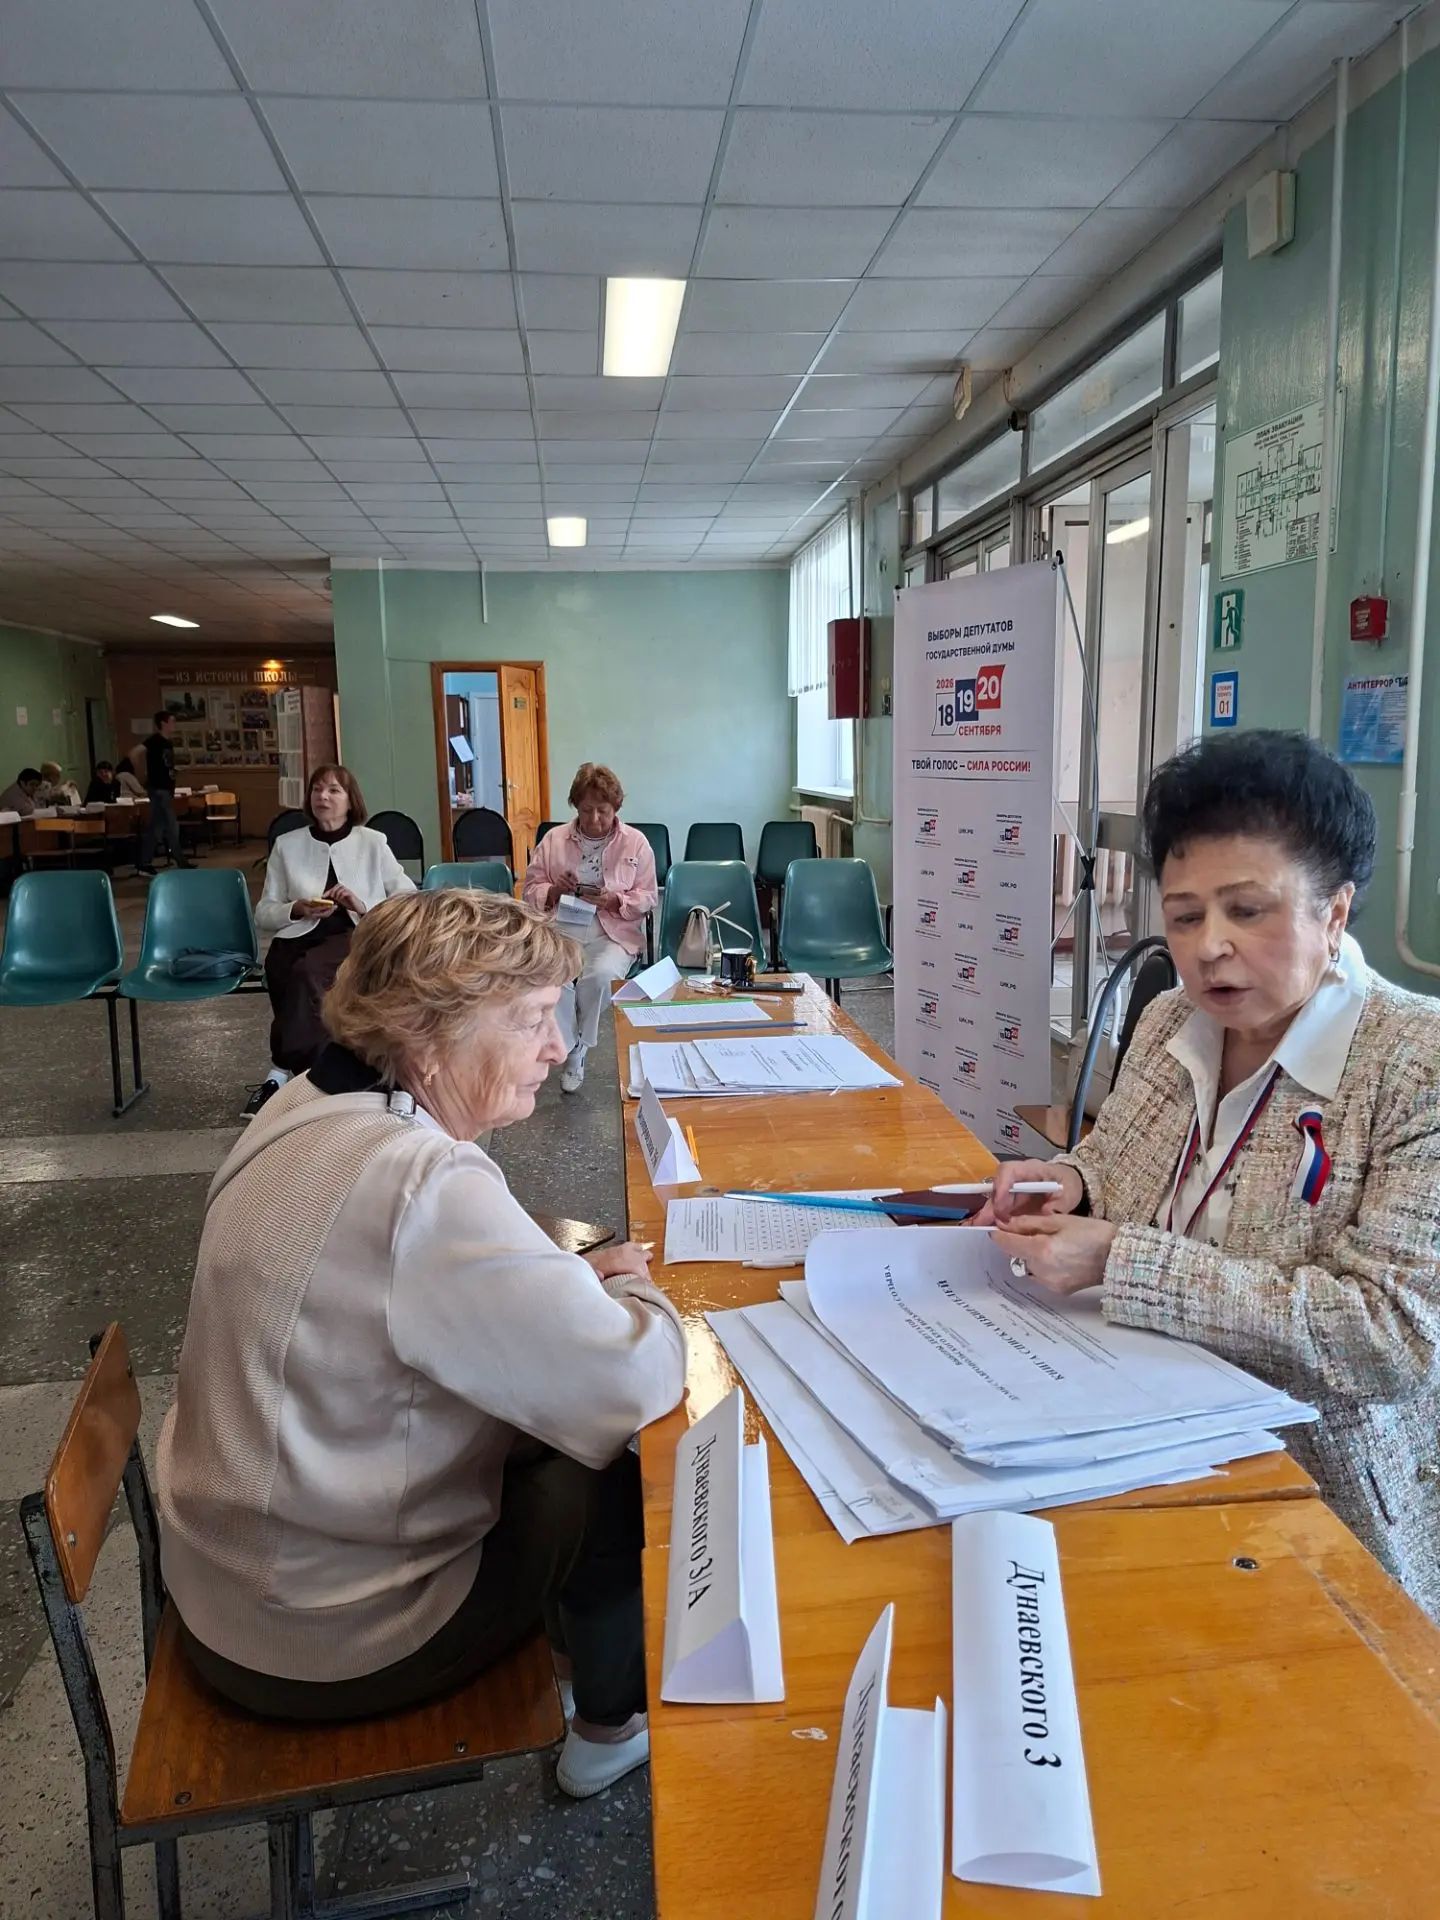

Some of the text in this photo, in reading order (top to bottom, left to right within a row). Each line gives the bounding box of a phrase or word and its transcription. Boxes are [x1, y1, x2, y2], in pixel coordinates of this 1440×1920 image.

[927, 619, 1013, 642] ВЫБОРЫ ДЕПУТАТОВ
[925, 641, 1015, 660] ГОСУДАРСТВЕННОЙ ДУМЫ
[176, 671, 297, 682] ИЗ ИСТОРИИ ШКОЛЫ
[936, 678, 954, 689] 2026
[1346, 678, 1394, 690] АНТИТЕРРОР
[938, 675, 1000, 727] 18 19 20
[1219, 700, 1230, 715] 01
[958, 724, 1002, 736] СЕНТЯБРЯ
[911, 757, 931, 770] ТВОЙ
[932, 759, 958, 770] ГОЛОС
[967, 760, 989, 772] СИЛА
[991, 760, 1031, 773] РОССИИ!
[884, 1264, 901, 1301] СОЗЫВА
[937, 1279, 996, 1327] ИЗБИРАТЕЛЕЙ
[994, 1326, 1031, 1354] СПИСКА
[1029, 1354, 1064, 1380] КНИГА
[688, 1433, 717, 1610] Дунаевского 3/А
[1006, 1559, 1062, 1768] Дунаевского 3
